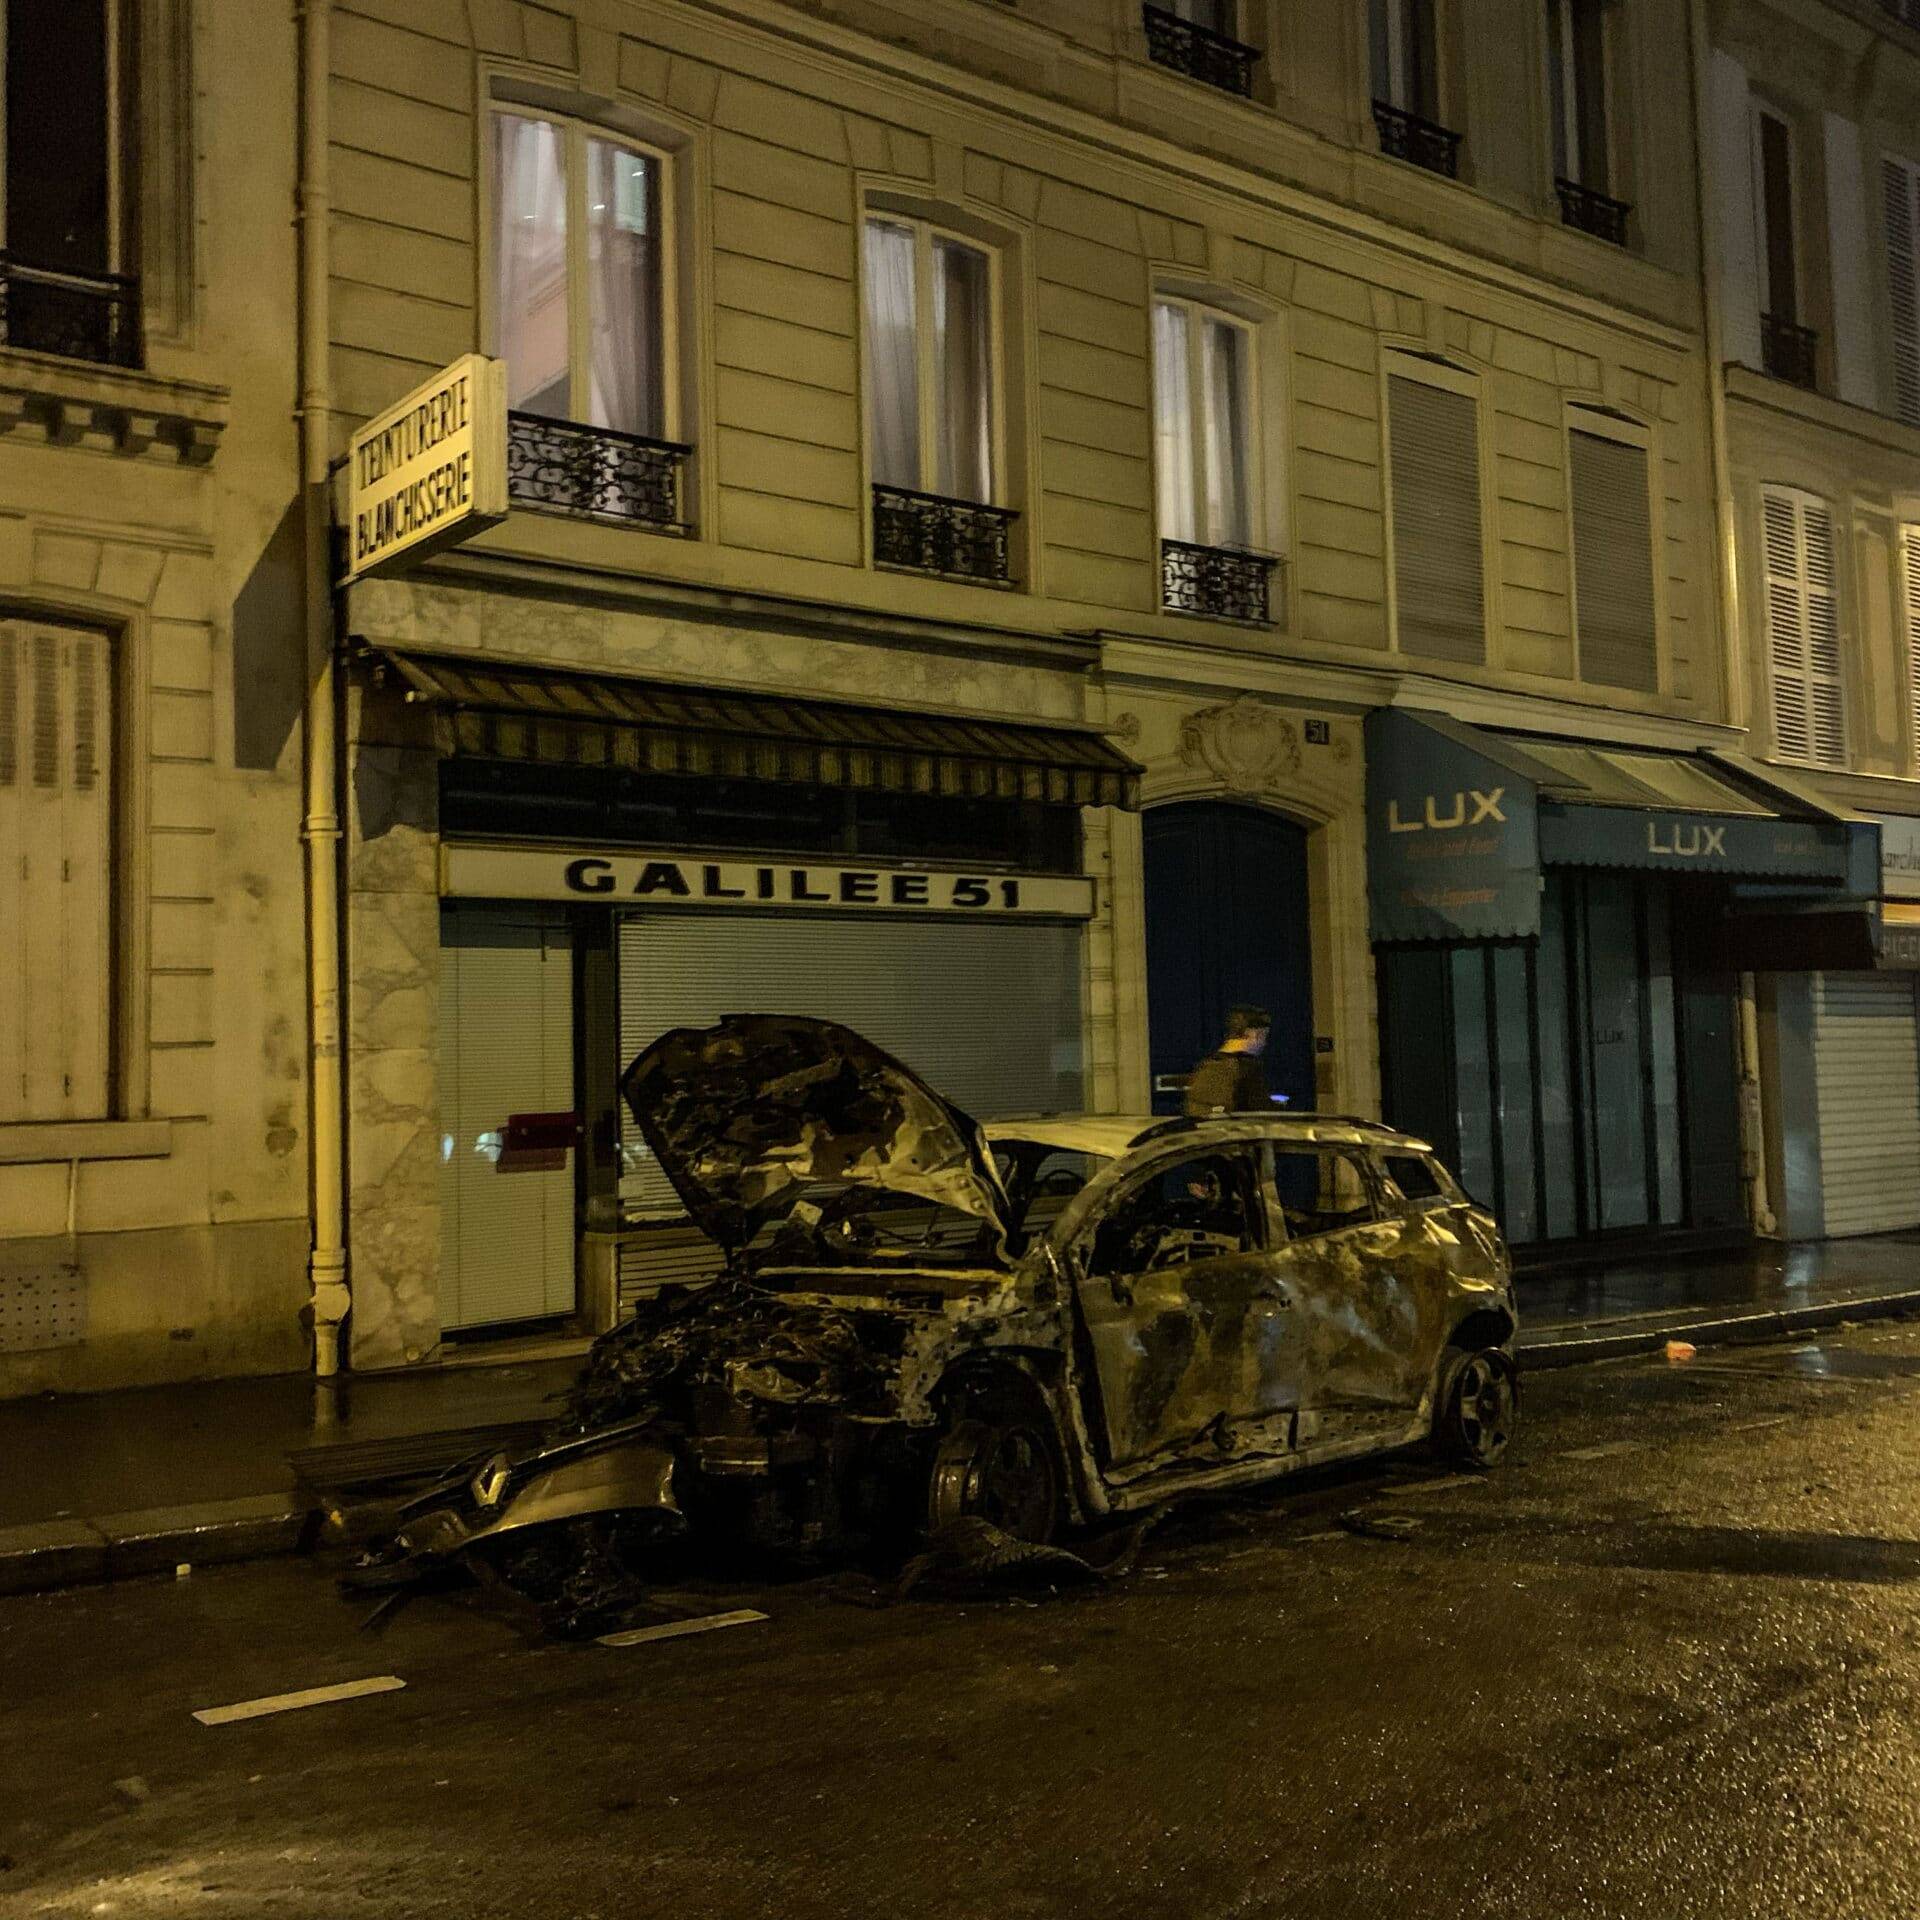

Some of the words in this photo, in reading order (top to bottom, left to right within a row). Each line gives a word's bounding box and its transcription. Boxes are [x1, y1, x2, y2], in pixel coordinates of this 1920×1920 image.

[358, 376, 467, 491] TEINTURERIE
[358, 451, 469, 559] BLANCHISSERIE
[1388, 787, 1507, 832] LUX
[1649, 822, 1727, 857] LUX
[565, 859, 929, 905] GALILEE
[951, 878, 1020, 907] 51
